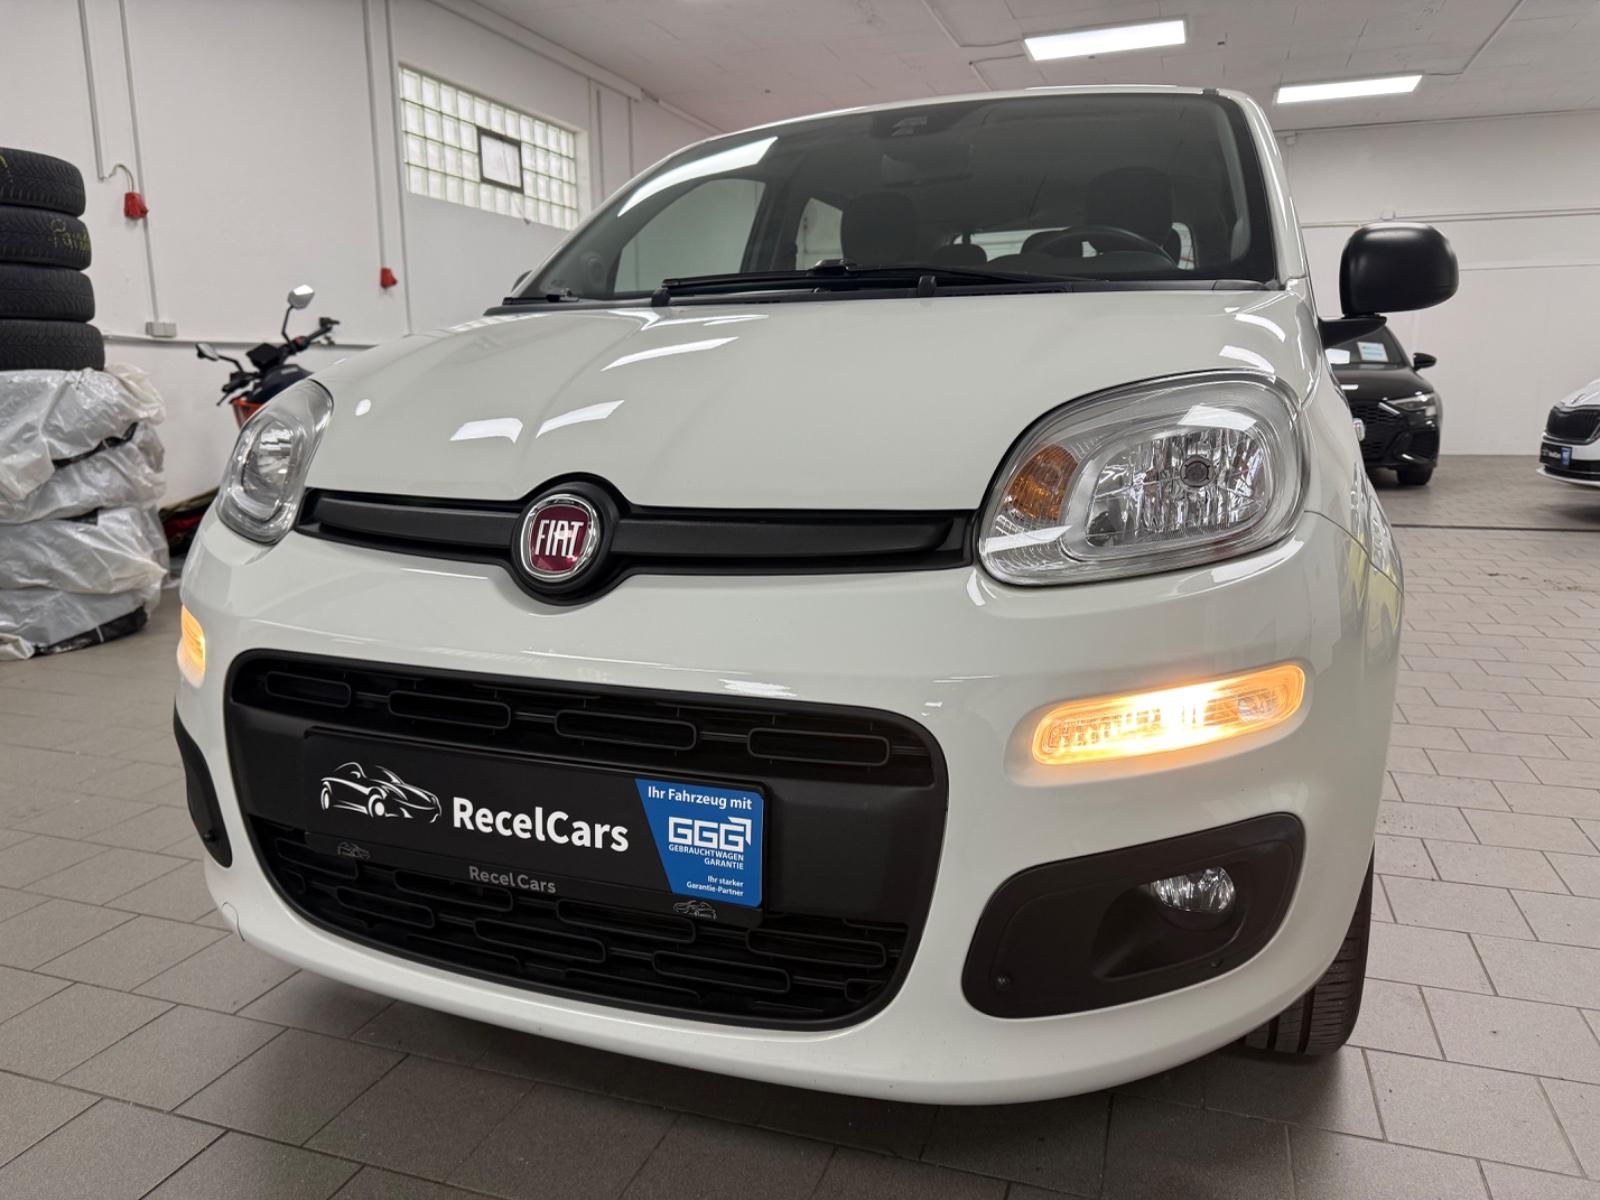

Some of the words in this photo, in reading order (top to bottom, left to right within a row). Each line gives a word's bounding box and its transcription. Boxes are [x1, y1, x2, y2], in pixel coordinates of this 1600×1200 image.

[535, 519, 584, 557] FIAT
[648, 786, 665, 799] Ihr
[668, 789, 727, 809] Fahrzeug
[730, 797, 752, 810] mit
[453, 797, 629, 852] RecelCars
[668, 843, 744, 861] GEBRAUCHTWAGEN
[704, 857, 744, 870] GARANTIE
[686, 881, 744, 896] Garantie-Partner
[707, 875, 717, 883] Ihr
[719, 877, 744, 887] starker
